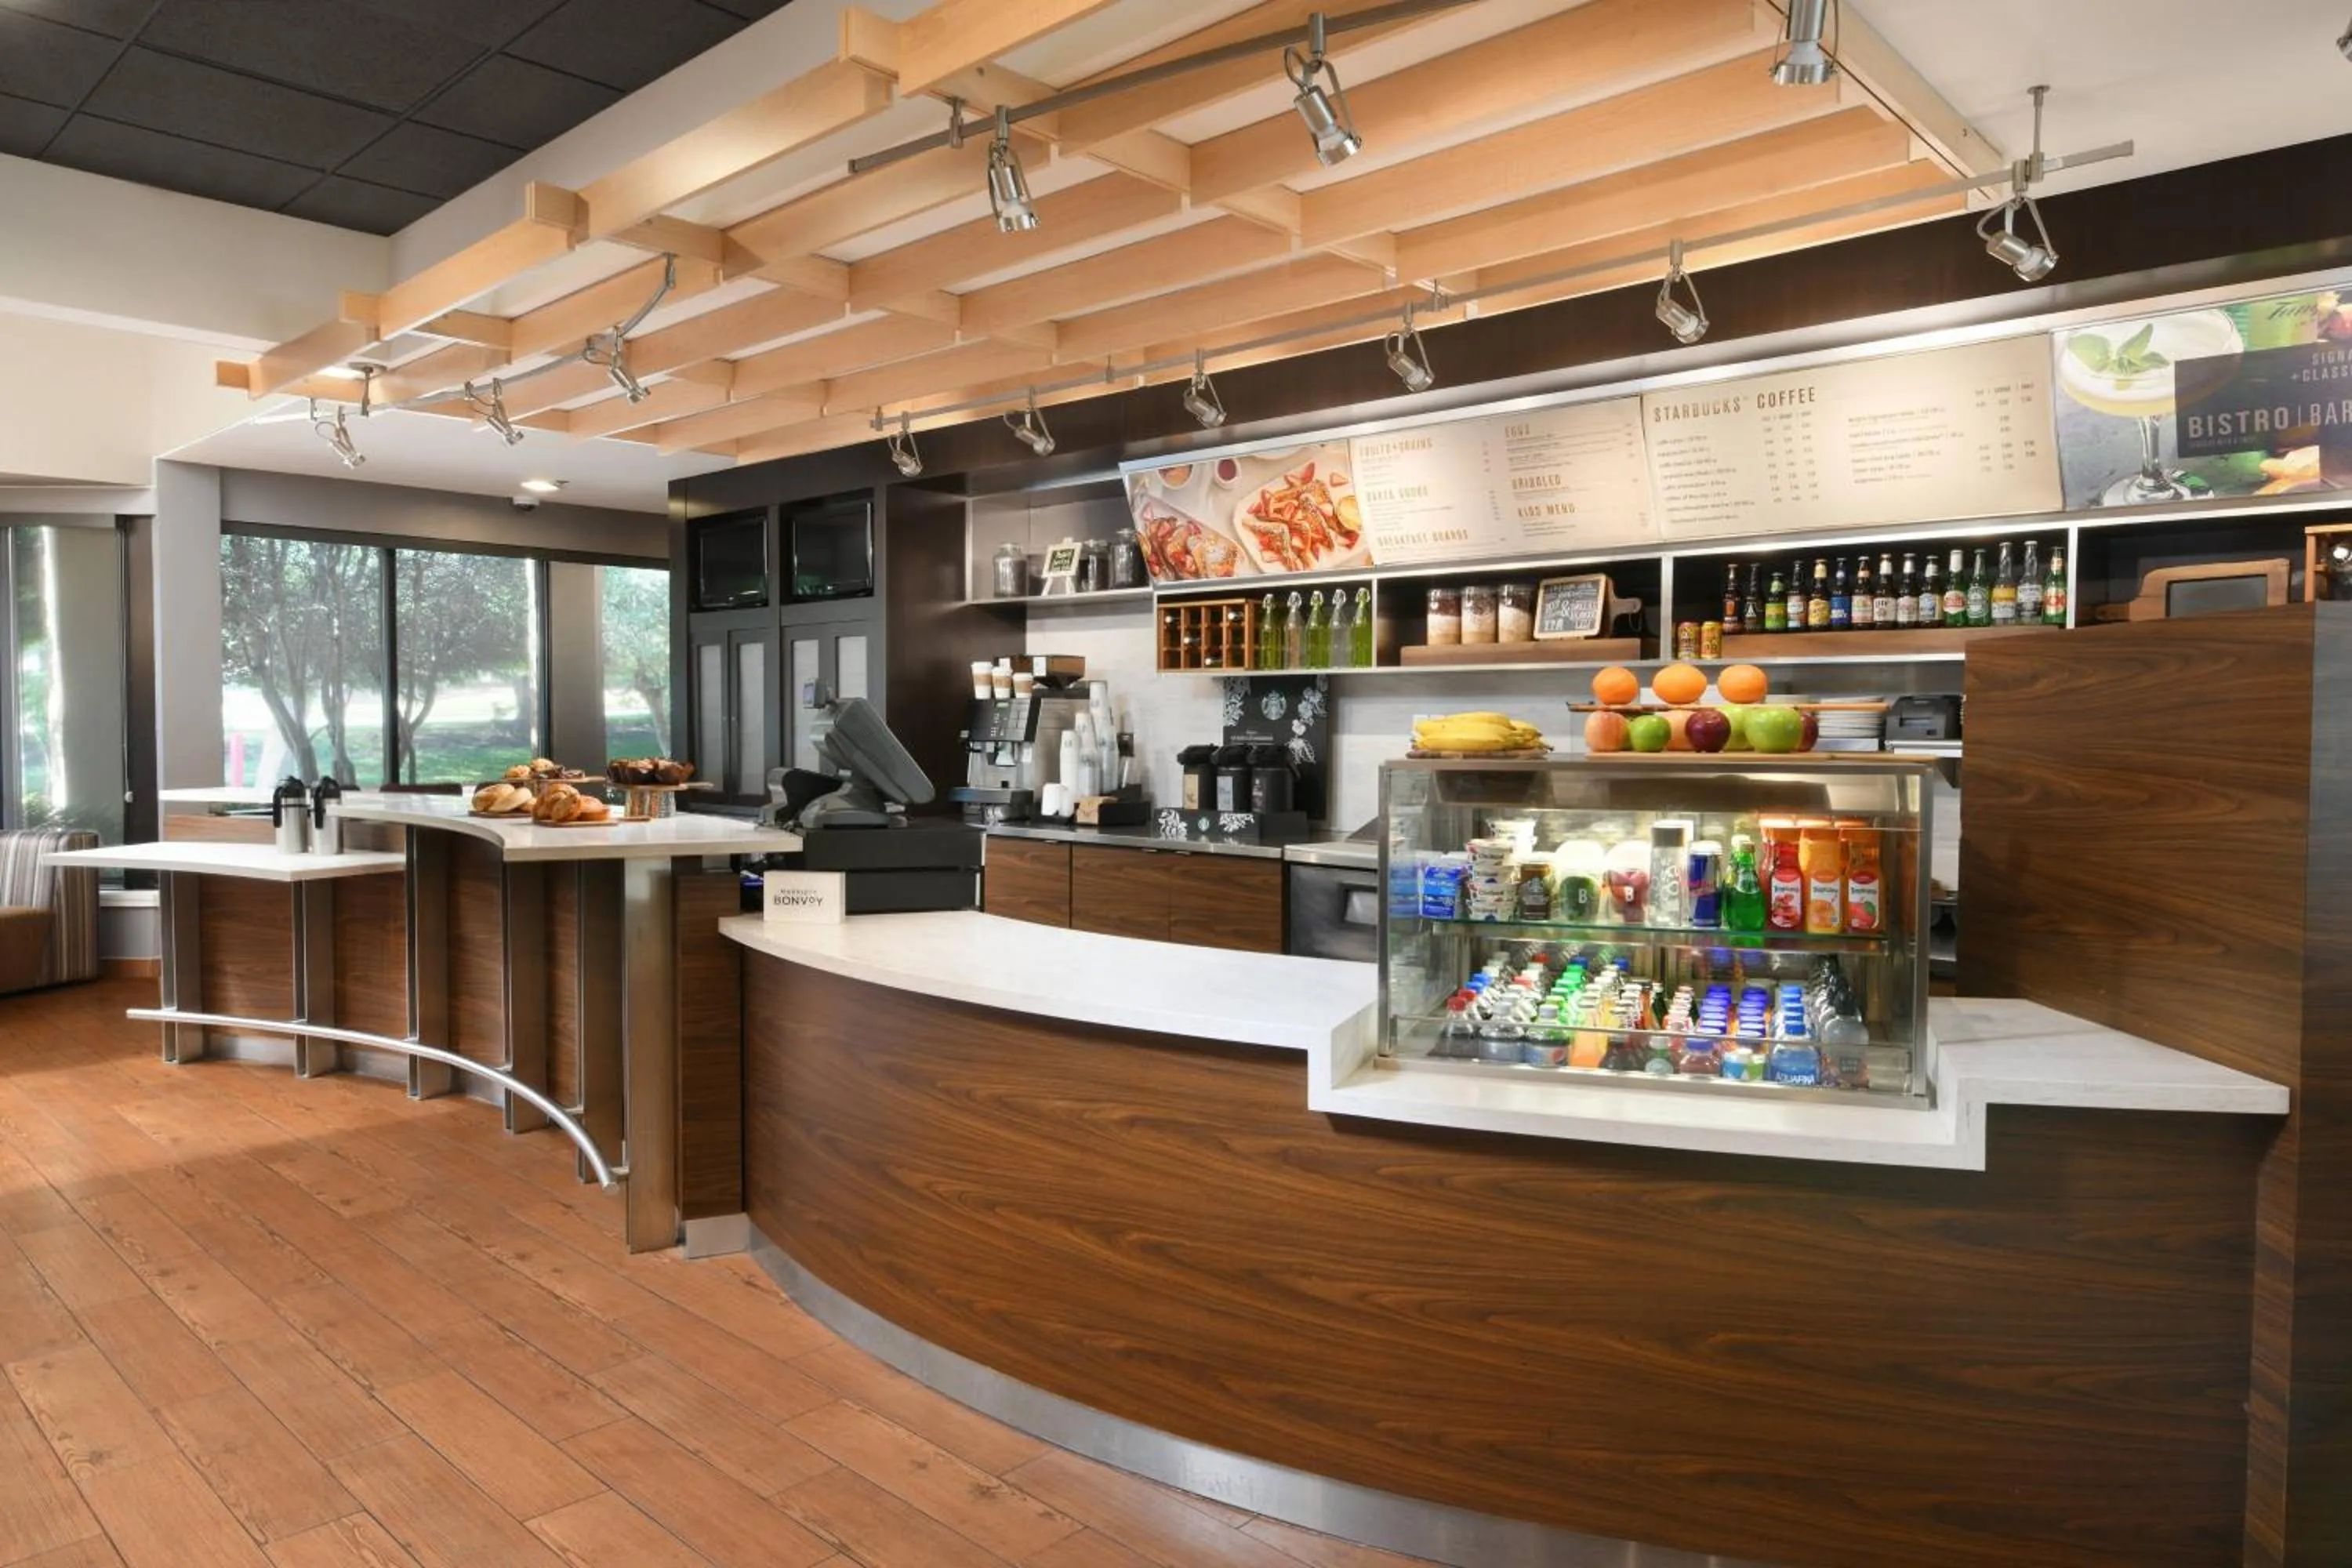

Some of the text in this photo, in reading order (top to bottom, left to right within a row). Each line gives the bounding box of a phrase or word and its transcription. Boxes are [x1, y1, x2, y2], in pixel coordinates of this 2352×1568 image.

[1654, 396, 1741, 423] STARBUCKS
[1757, 387, 1816, 409] COFFEE
[2188, 399, 2352, 439] BISTRO BAR
[774, 895, 824, 907] BONVOY
[1578, 888, 1588, 904] B
[1624, 886, 1634, 902] B
